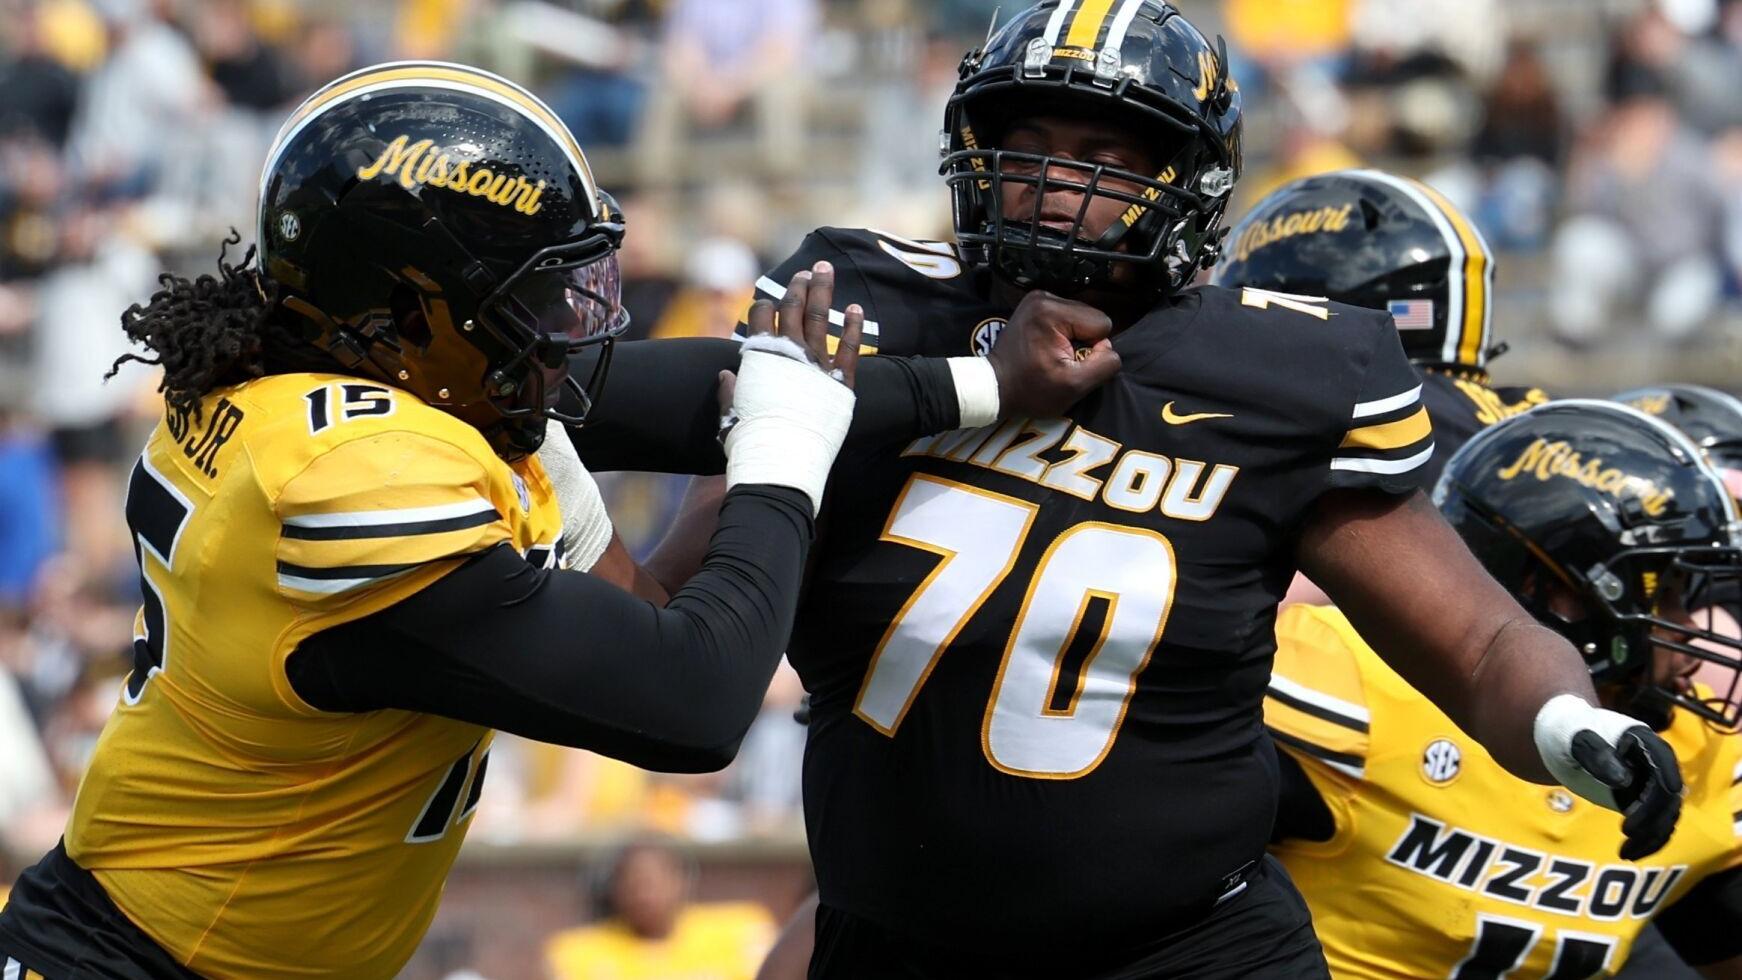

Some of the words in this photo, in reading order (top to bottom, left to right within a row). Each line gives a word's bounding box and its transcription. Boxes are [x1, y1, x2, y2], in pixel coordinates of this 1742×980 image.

[1053, 48, 1096, 62] MIZZOU
[358, 134, 547, 216] Missouri
[281, 214, 299, 239] SEC
[184, 398, 244, 479] JR.
[303, 382, 397, 437] 15
[851, 471, 1177, 780] 70
[1423, 739, 1461, 782] SEC
[1384, 812, 1689, 923] MIZZOU
